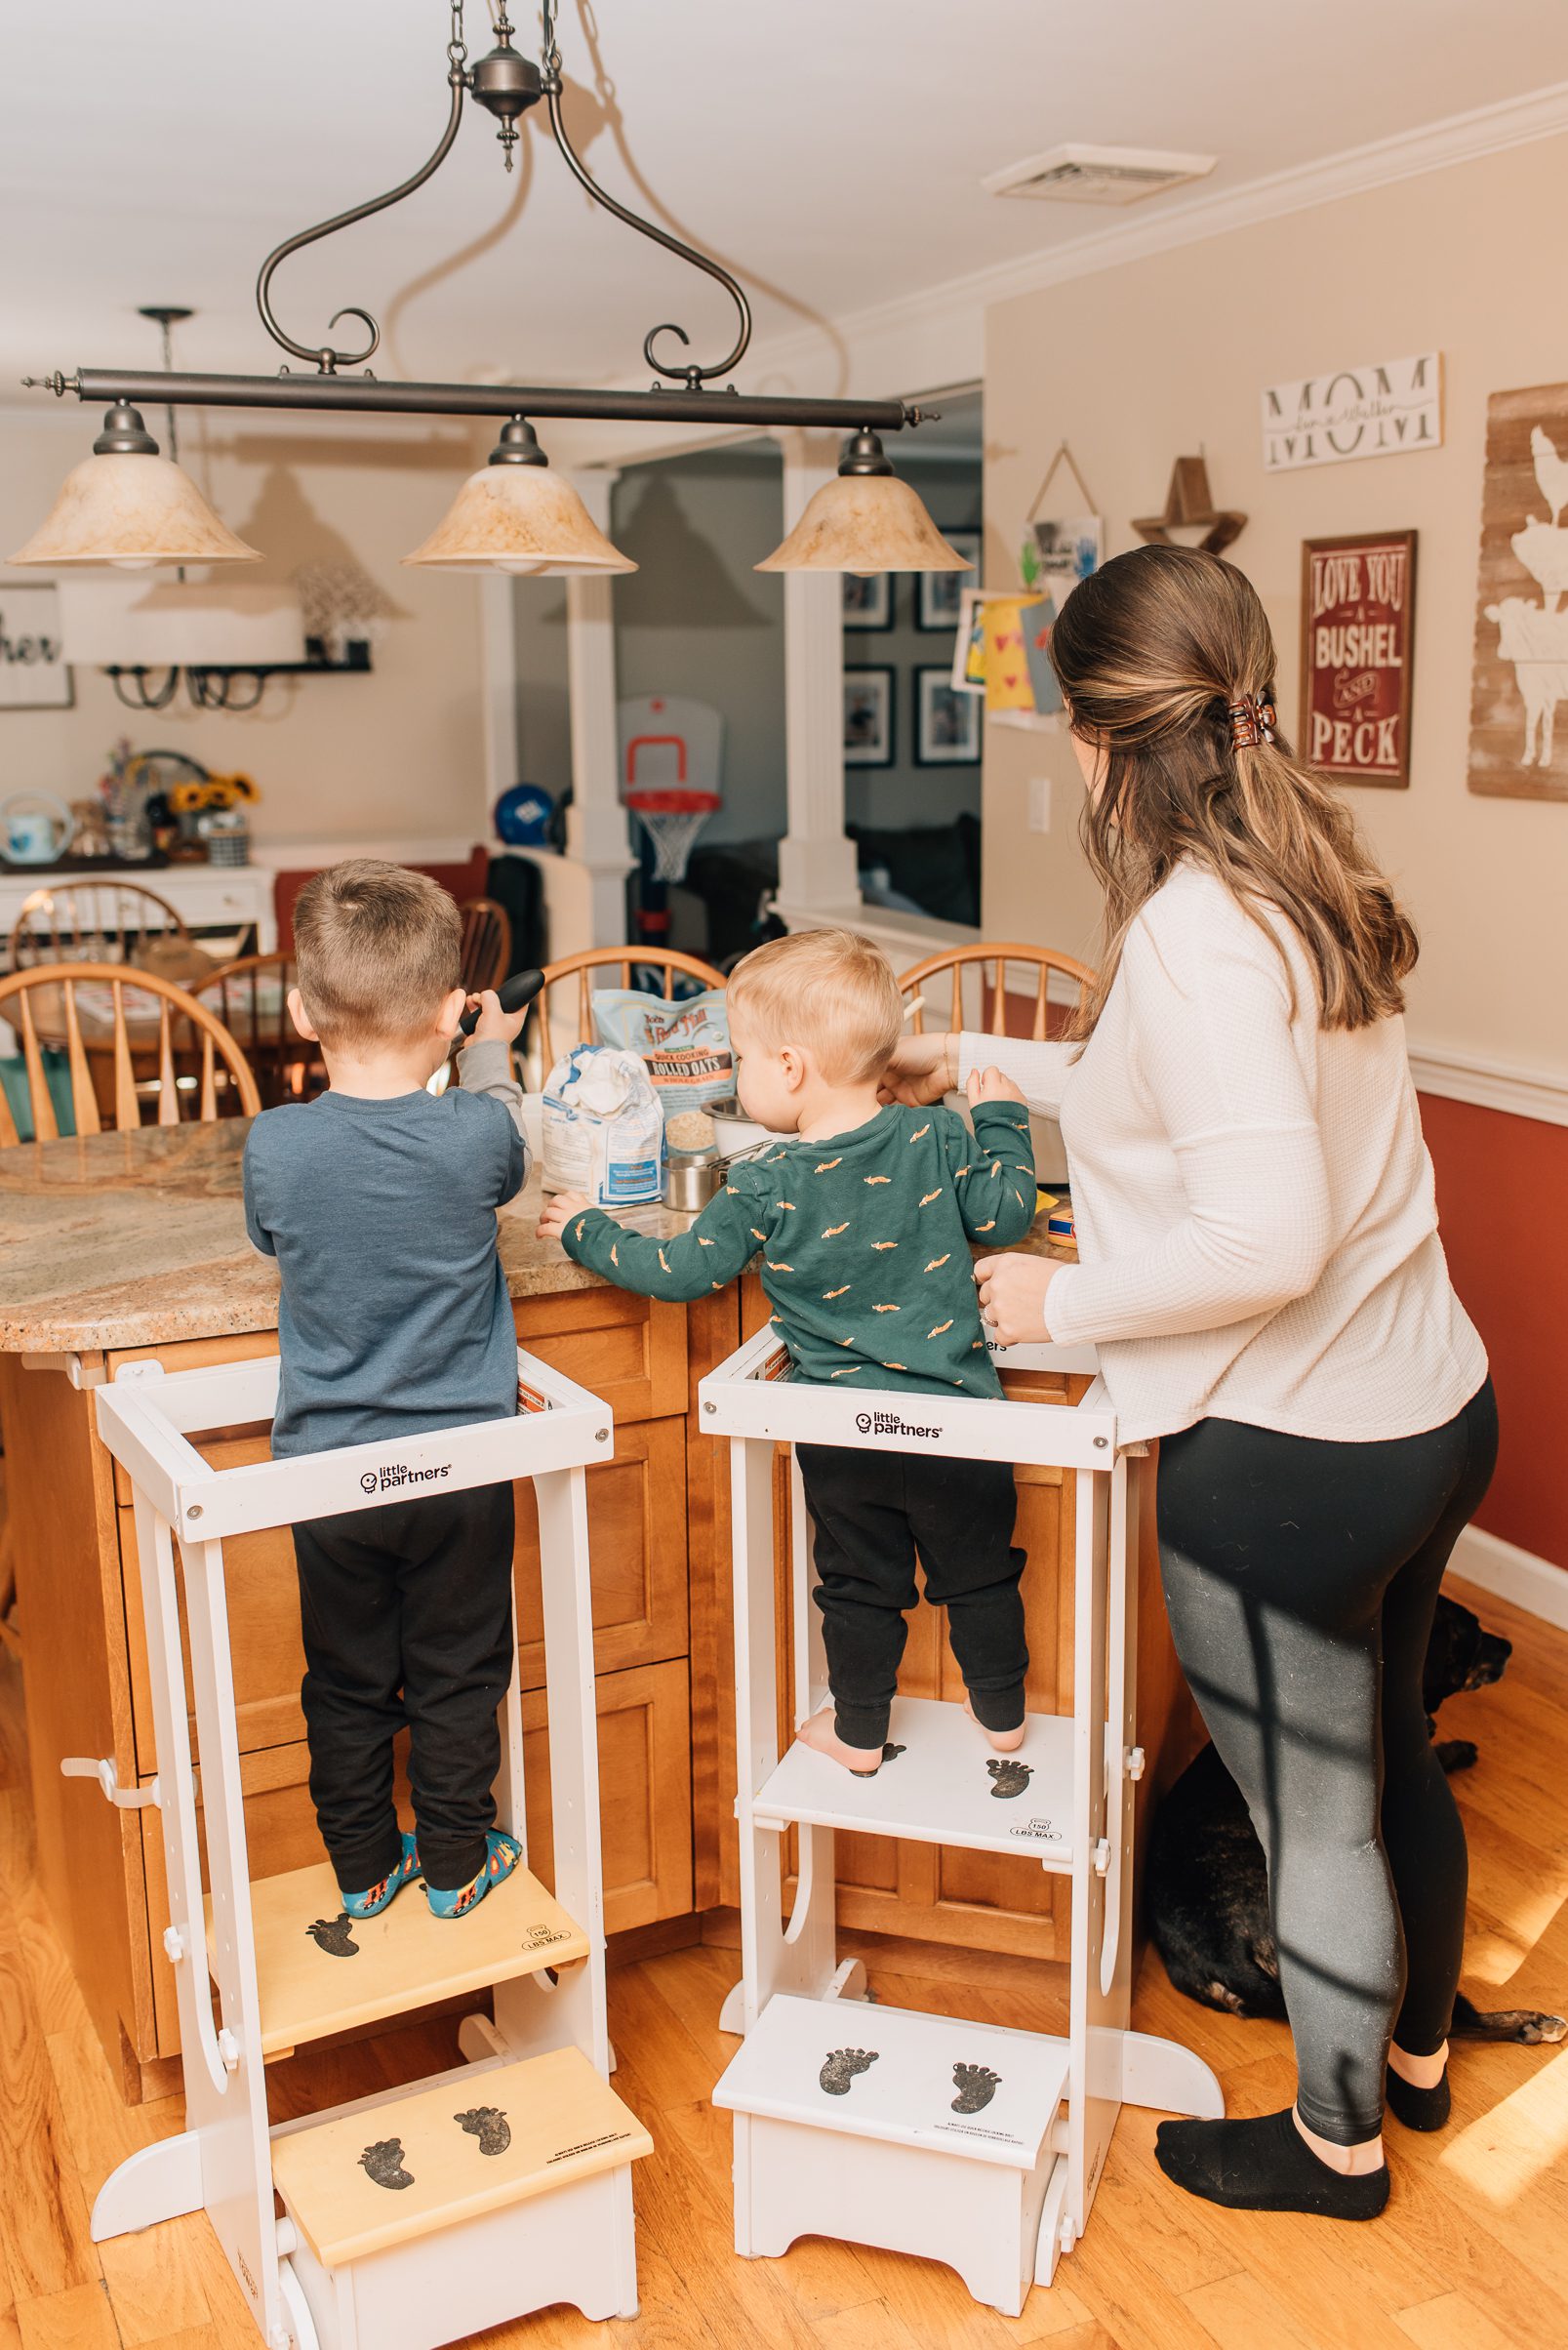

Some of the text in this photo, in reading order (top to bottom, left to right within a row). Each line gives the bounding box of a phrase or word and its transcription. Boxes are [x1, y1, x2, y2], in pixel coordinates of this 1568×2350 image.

[1267, 357, 1431, 466] MOM
[1312, 551, 1406, 619] LOVE YOU
[1355, 605, 1365, 623] A
[1315, 624, 1403, 669] BUSHEL
[1340, 675, 1376, 702] AND
[1352, 706, 1364, 722] A
[1312, 710, 1400, 765] PECK
[675, 1049, 708, 1061] COOKING
[652, 1057, 720, 1076] ROLLED OATS
[874, 1411, 901, 1424] little
[380, 1464, 408, 1478] little
